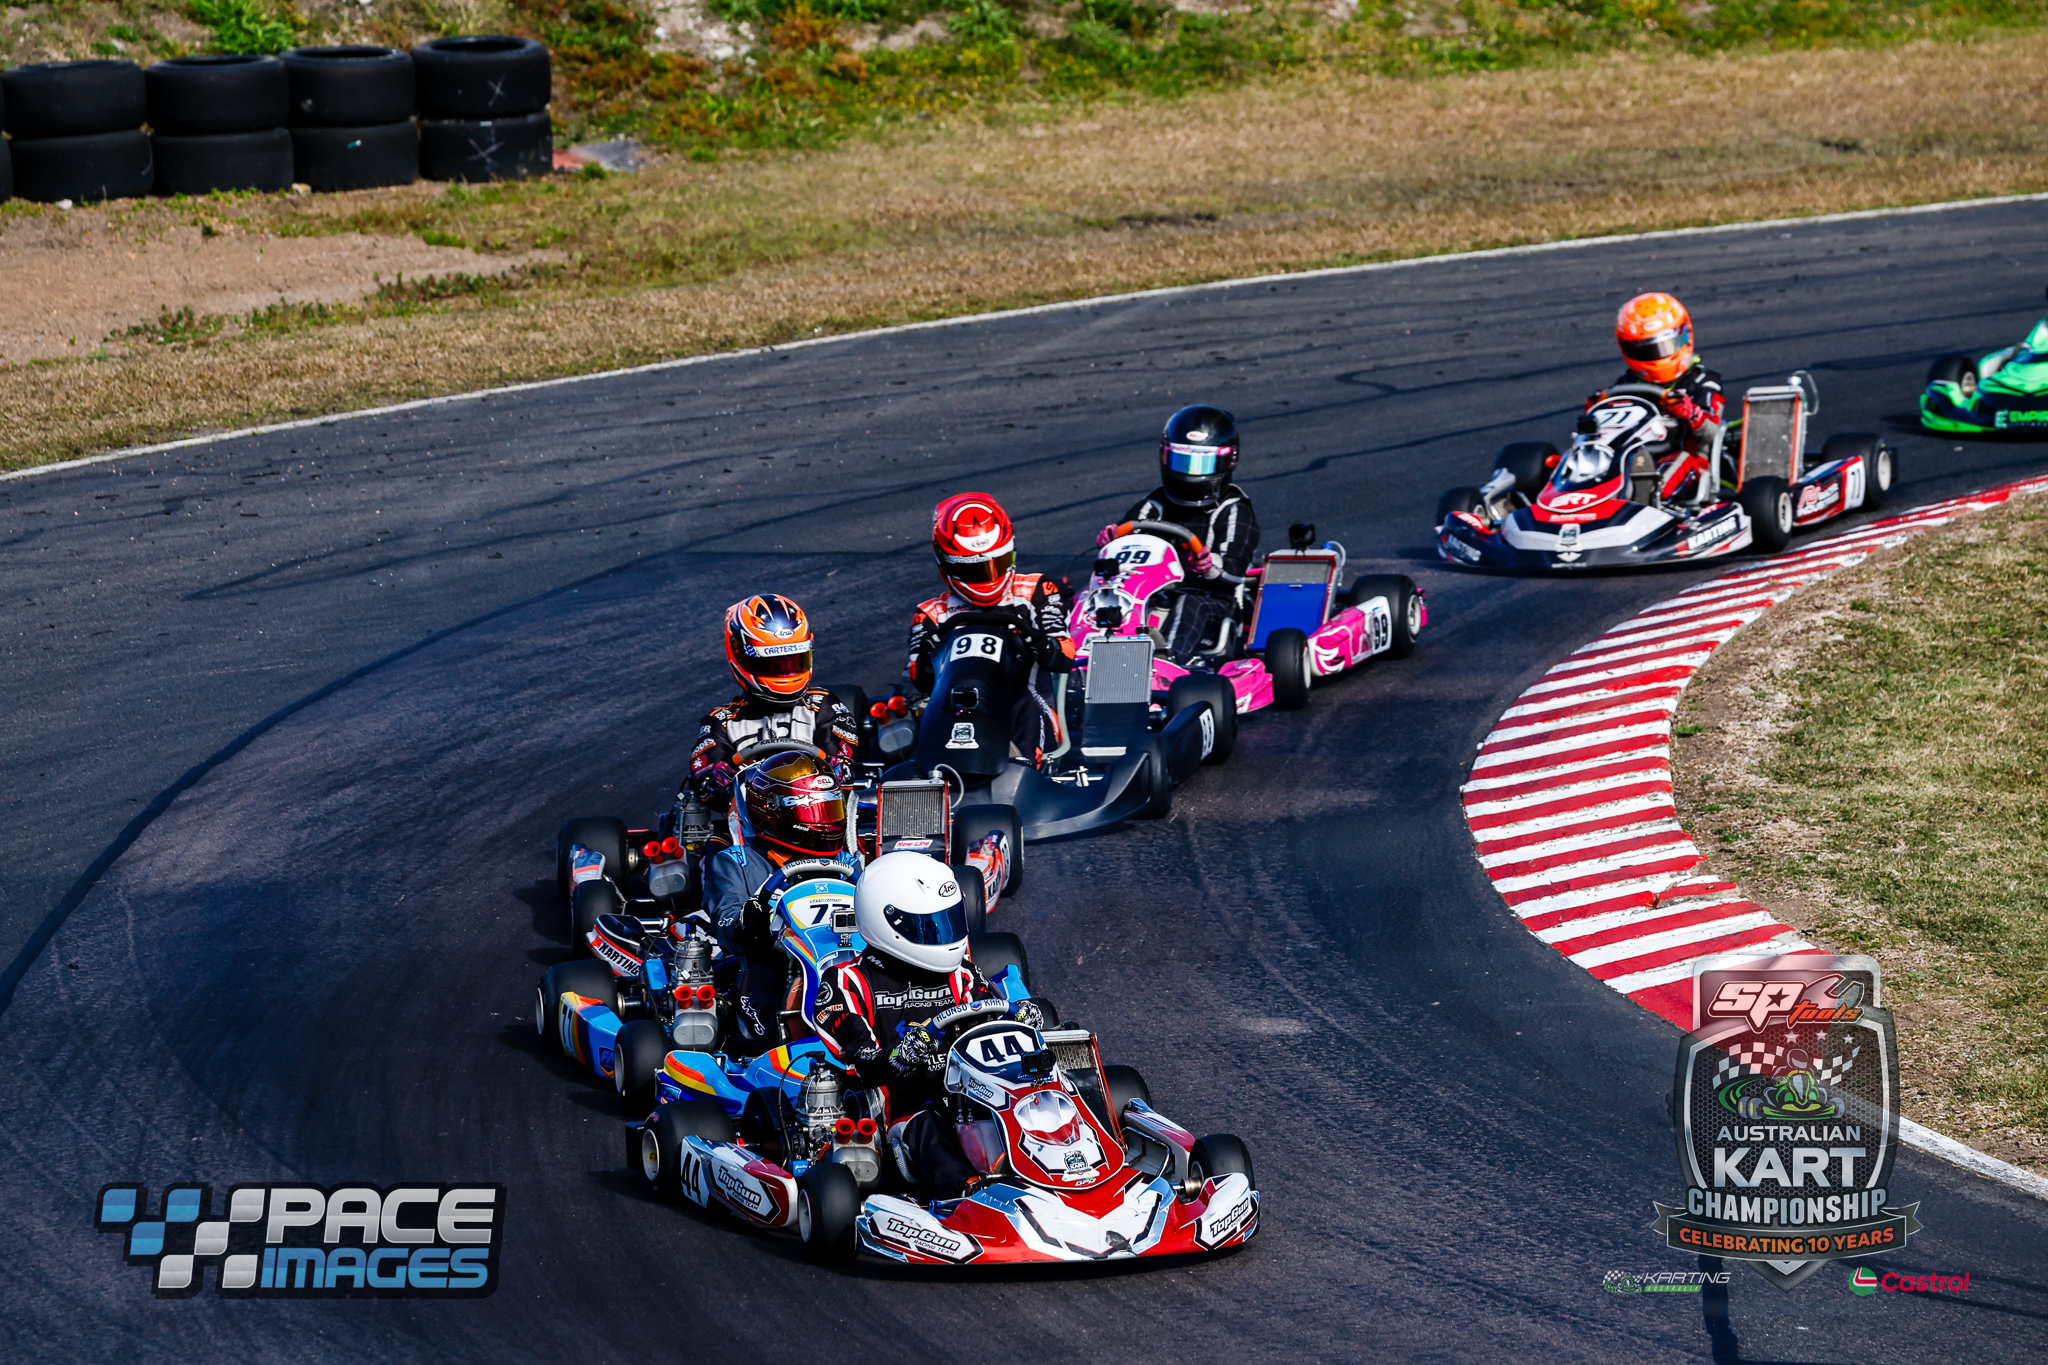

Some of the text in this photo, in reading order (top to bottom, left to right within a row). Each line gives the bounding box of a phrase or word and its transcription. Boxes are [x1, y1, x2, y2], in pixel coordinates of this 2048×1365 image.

[1687, 517, 1738, 550] KARTING
[1115, 550, 1151, 564] 99
[955, 636, 997, 655] 98
[598, 942, 640, 975] KARTING
[934, 999, 956, 1007] TEAM
[936, 1004, 968, 1022] ALONSO
[980, 1035, 1025, 1063] 44
[968, 1077, 994, 1098] TopGun
[682, 1151, 703, 1204] 44
[719, 1165, 761, 1205] TopGun
[745, 1201, 759, 1210] TEAM
[1210, 1197, 1249, 1238] TopGun
[887, 1218, 961, 1252] TopGun
[914, 1240, 955, 1256] RACING TEAM
